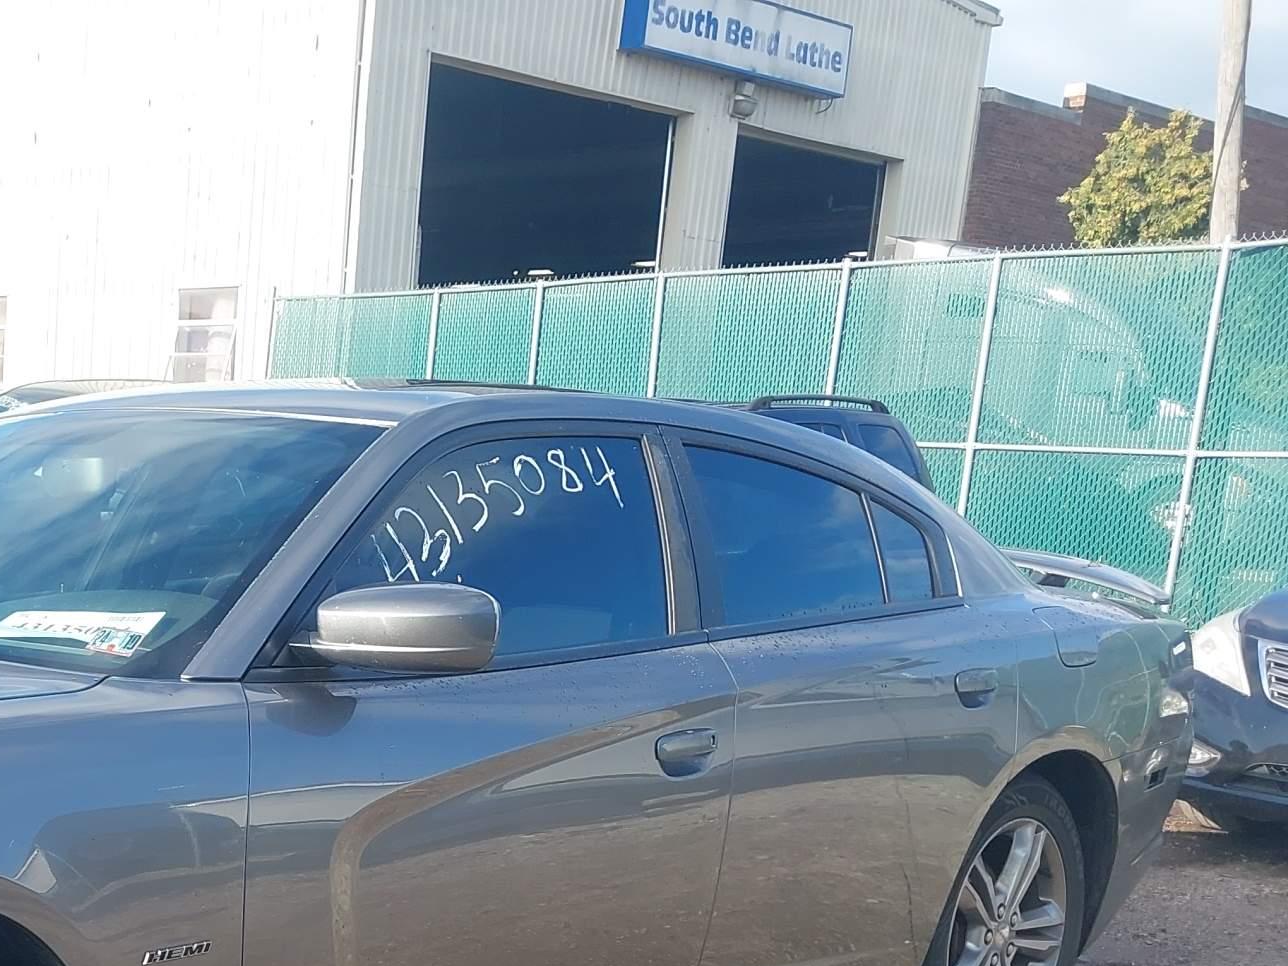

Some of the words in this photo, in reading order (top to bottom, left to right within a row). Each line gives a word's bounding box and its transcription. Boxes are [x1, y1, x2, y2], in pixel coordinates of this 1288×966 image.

[652, 0, 719, 41] South
[725, 17, 781, 57] Bend
[787, 34, 843, 73] Lathe
[370, 446, 624, 582] 43135084
[142, 940, 212, 966] HEMI
